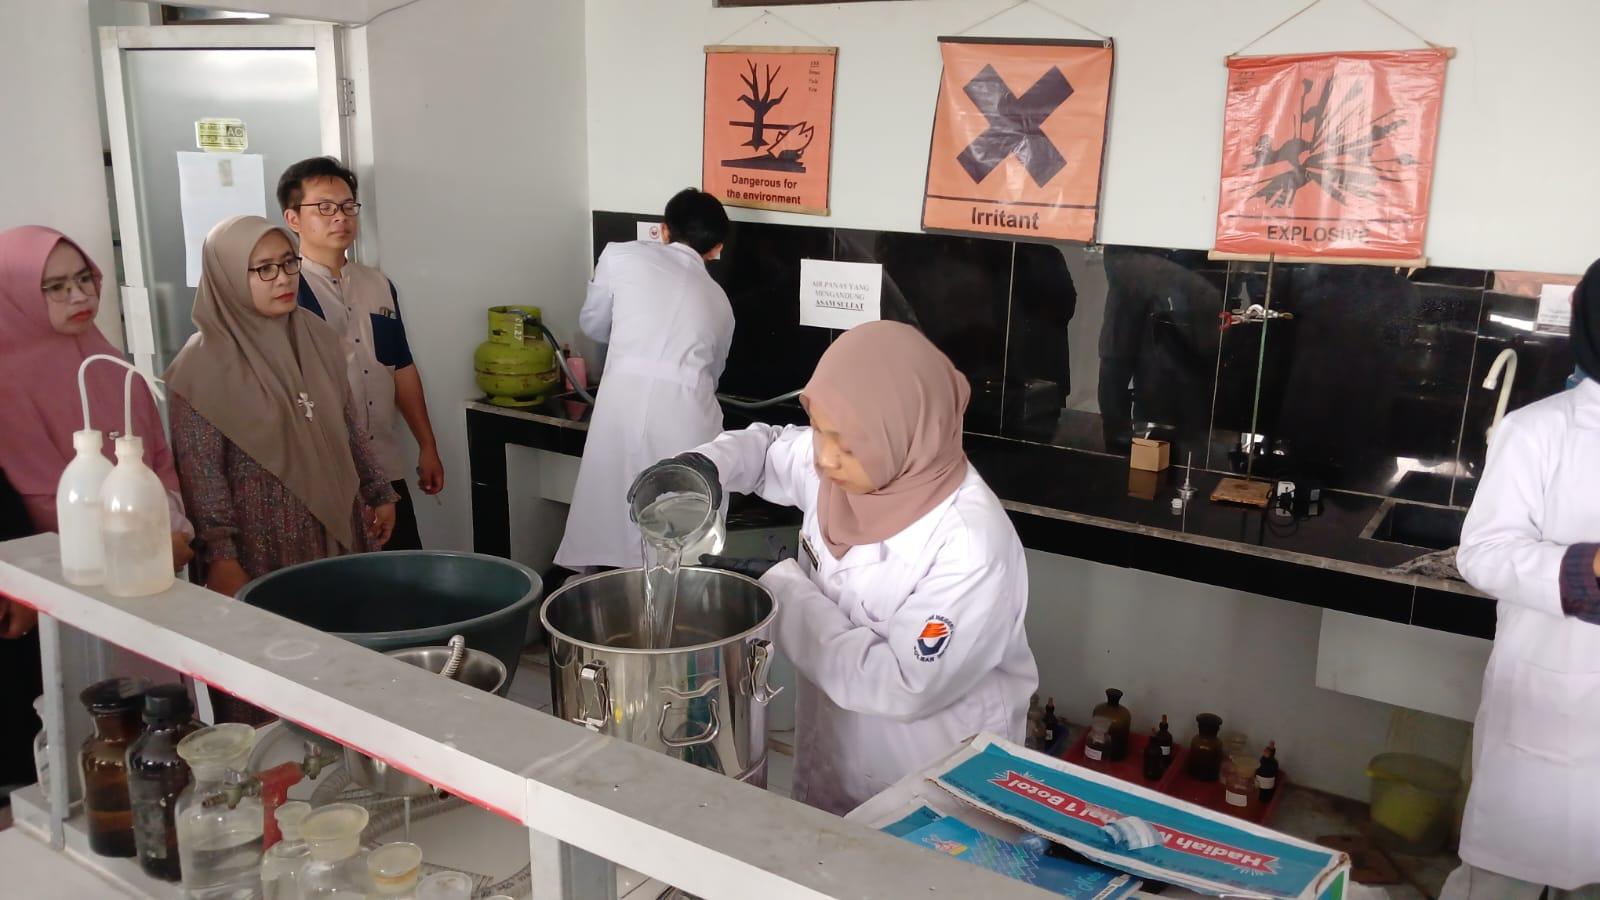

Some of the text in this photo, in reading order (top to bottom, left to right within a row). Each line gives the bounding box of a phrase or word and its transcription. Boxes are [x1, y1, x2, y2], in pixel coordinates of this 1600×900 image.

[732, 174, 797, 189] Dangerous for
[727, 189, 801, 204] the environment
[971, 207, 1039, 230] Irritant
[815, 289, 865, 300] MENGANDUNG
[849, 283, 870, 291] YANG
[1008, 779, 1065, 806] Botol
[1065, 802, 1077, 812] 1
[1176, 837, 1262, 867] Hadiah
